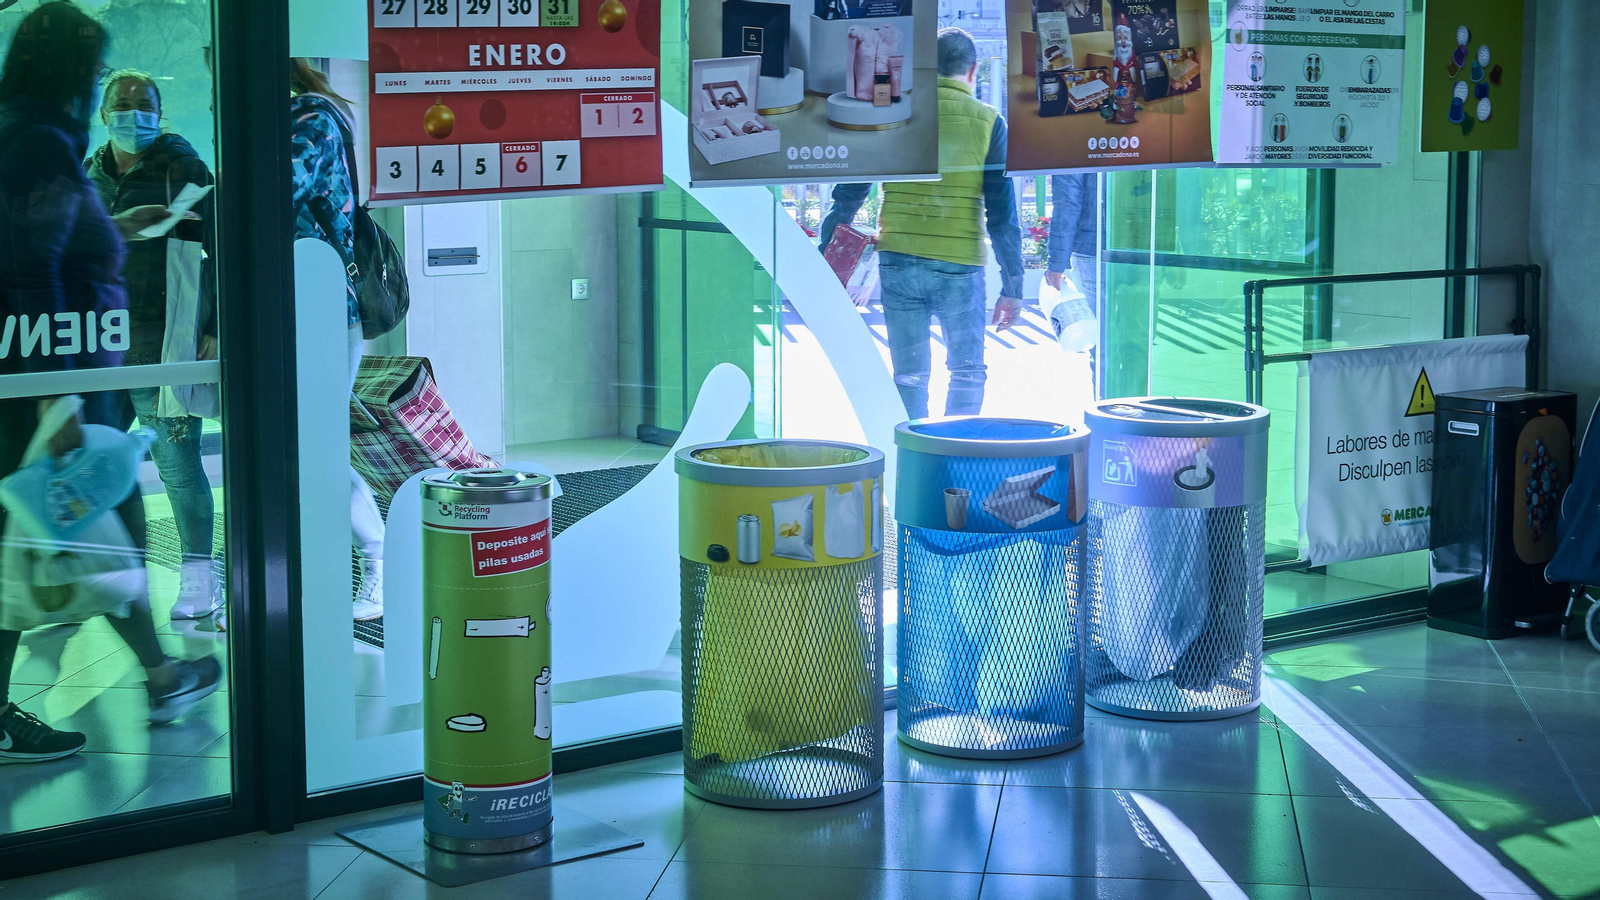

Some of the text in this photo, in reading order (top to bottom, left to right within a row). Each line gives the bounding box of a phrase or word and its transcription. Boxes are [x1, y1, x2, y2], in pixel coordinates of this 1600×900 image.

[382, 0, 568, 15] 27 28 29 30 31
[1128, 5, 1145, 15] 70%
[1092, 13, 1100, 23] 16
[1251, 33, 1358, 44] PERSONAS CON PREFERENCIA:
[469, 43, 566, 66] ENERO
[585, 74, 611, 82] SÁBADO
[596, 108, 643, 125] 1 2
[390, 155, 567, 178] 3 4 5 6 7
[1327, 433, 1386, 455] Labores
[1392, 430, 1410, 447] de
[1339, 456, 1433, 482] Disculpen las
[454, 506, 490, 514] Recycling
[477, 535, 528, 551] Deposite
[479, 548, 544, 570] pilas usadas
